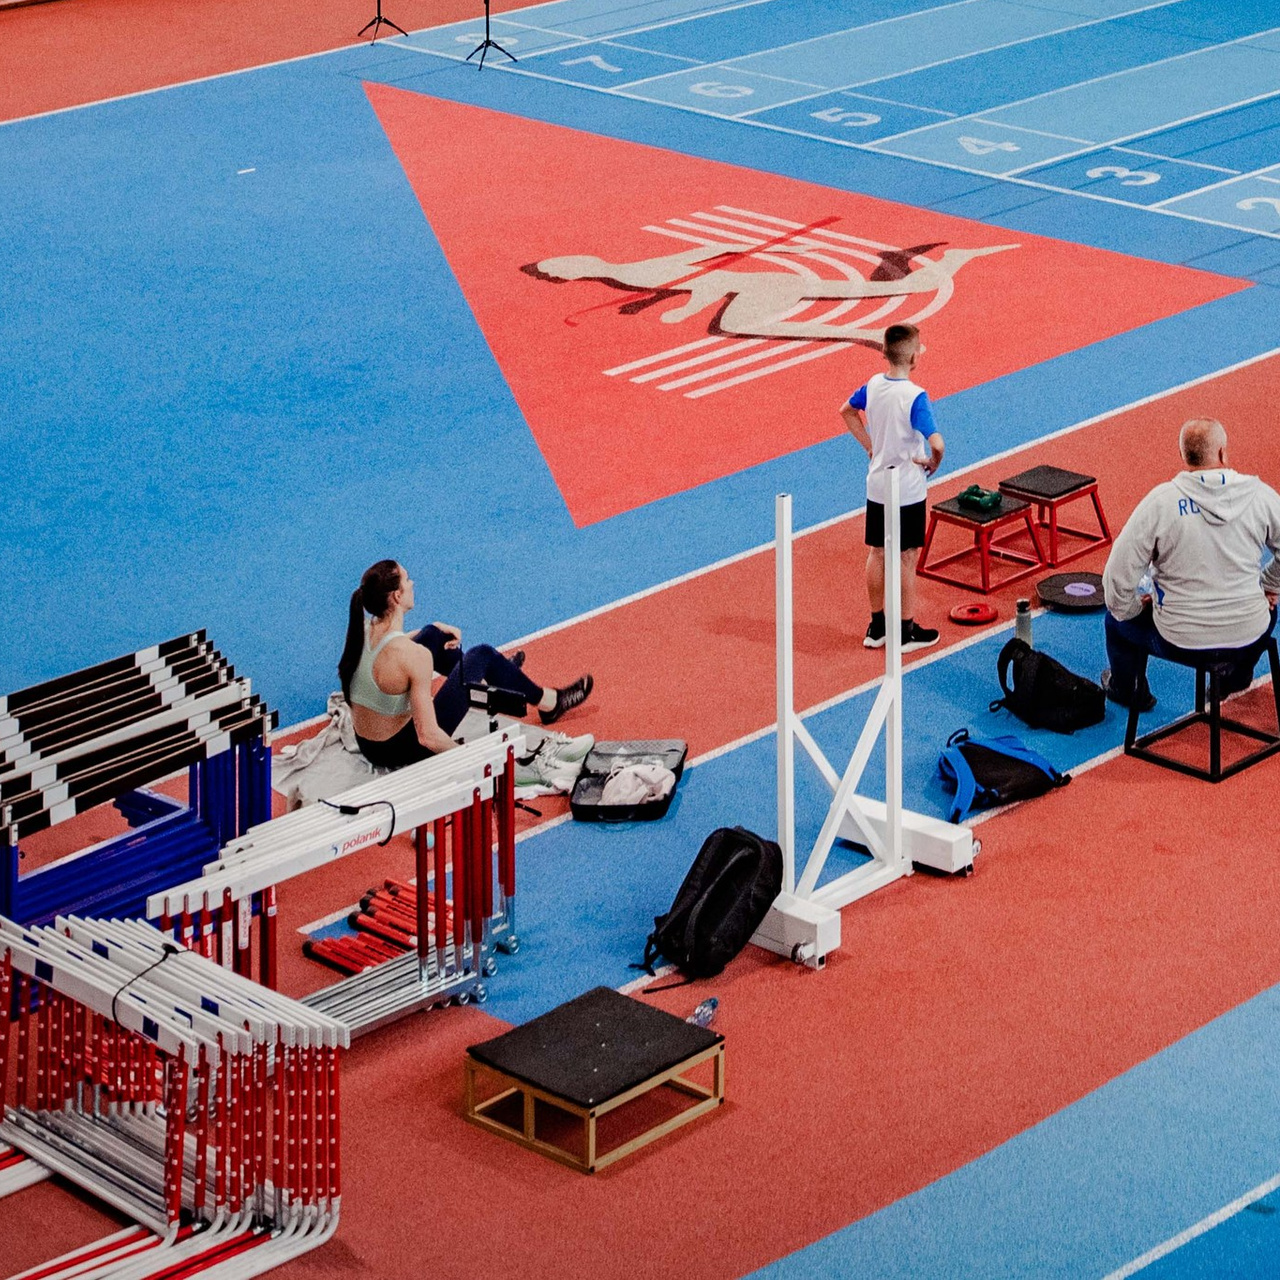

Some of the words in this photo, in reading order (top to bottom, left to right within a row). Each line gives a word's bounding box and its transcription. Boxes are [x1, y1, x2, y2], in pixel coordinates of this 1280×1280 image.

[560, 54, 623, 73] 7
[689, 81, 754, 98] 6
[809, 107, 882, 127] 5
[958, 136, 1021, 156] 4
[1086, 166, 1161, 186] 3
[342, 827, 381, 853] polanik
